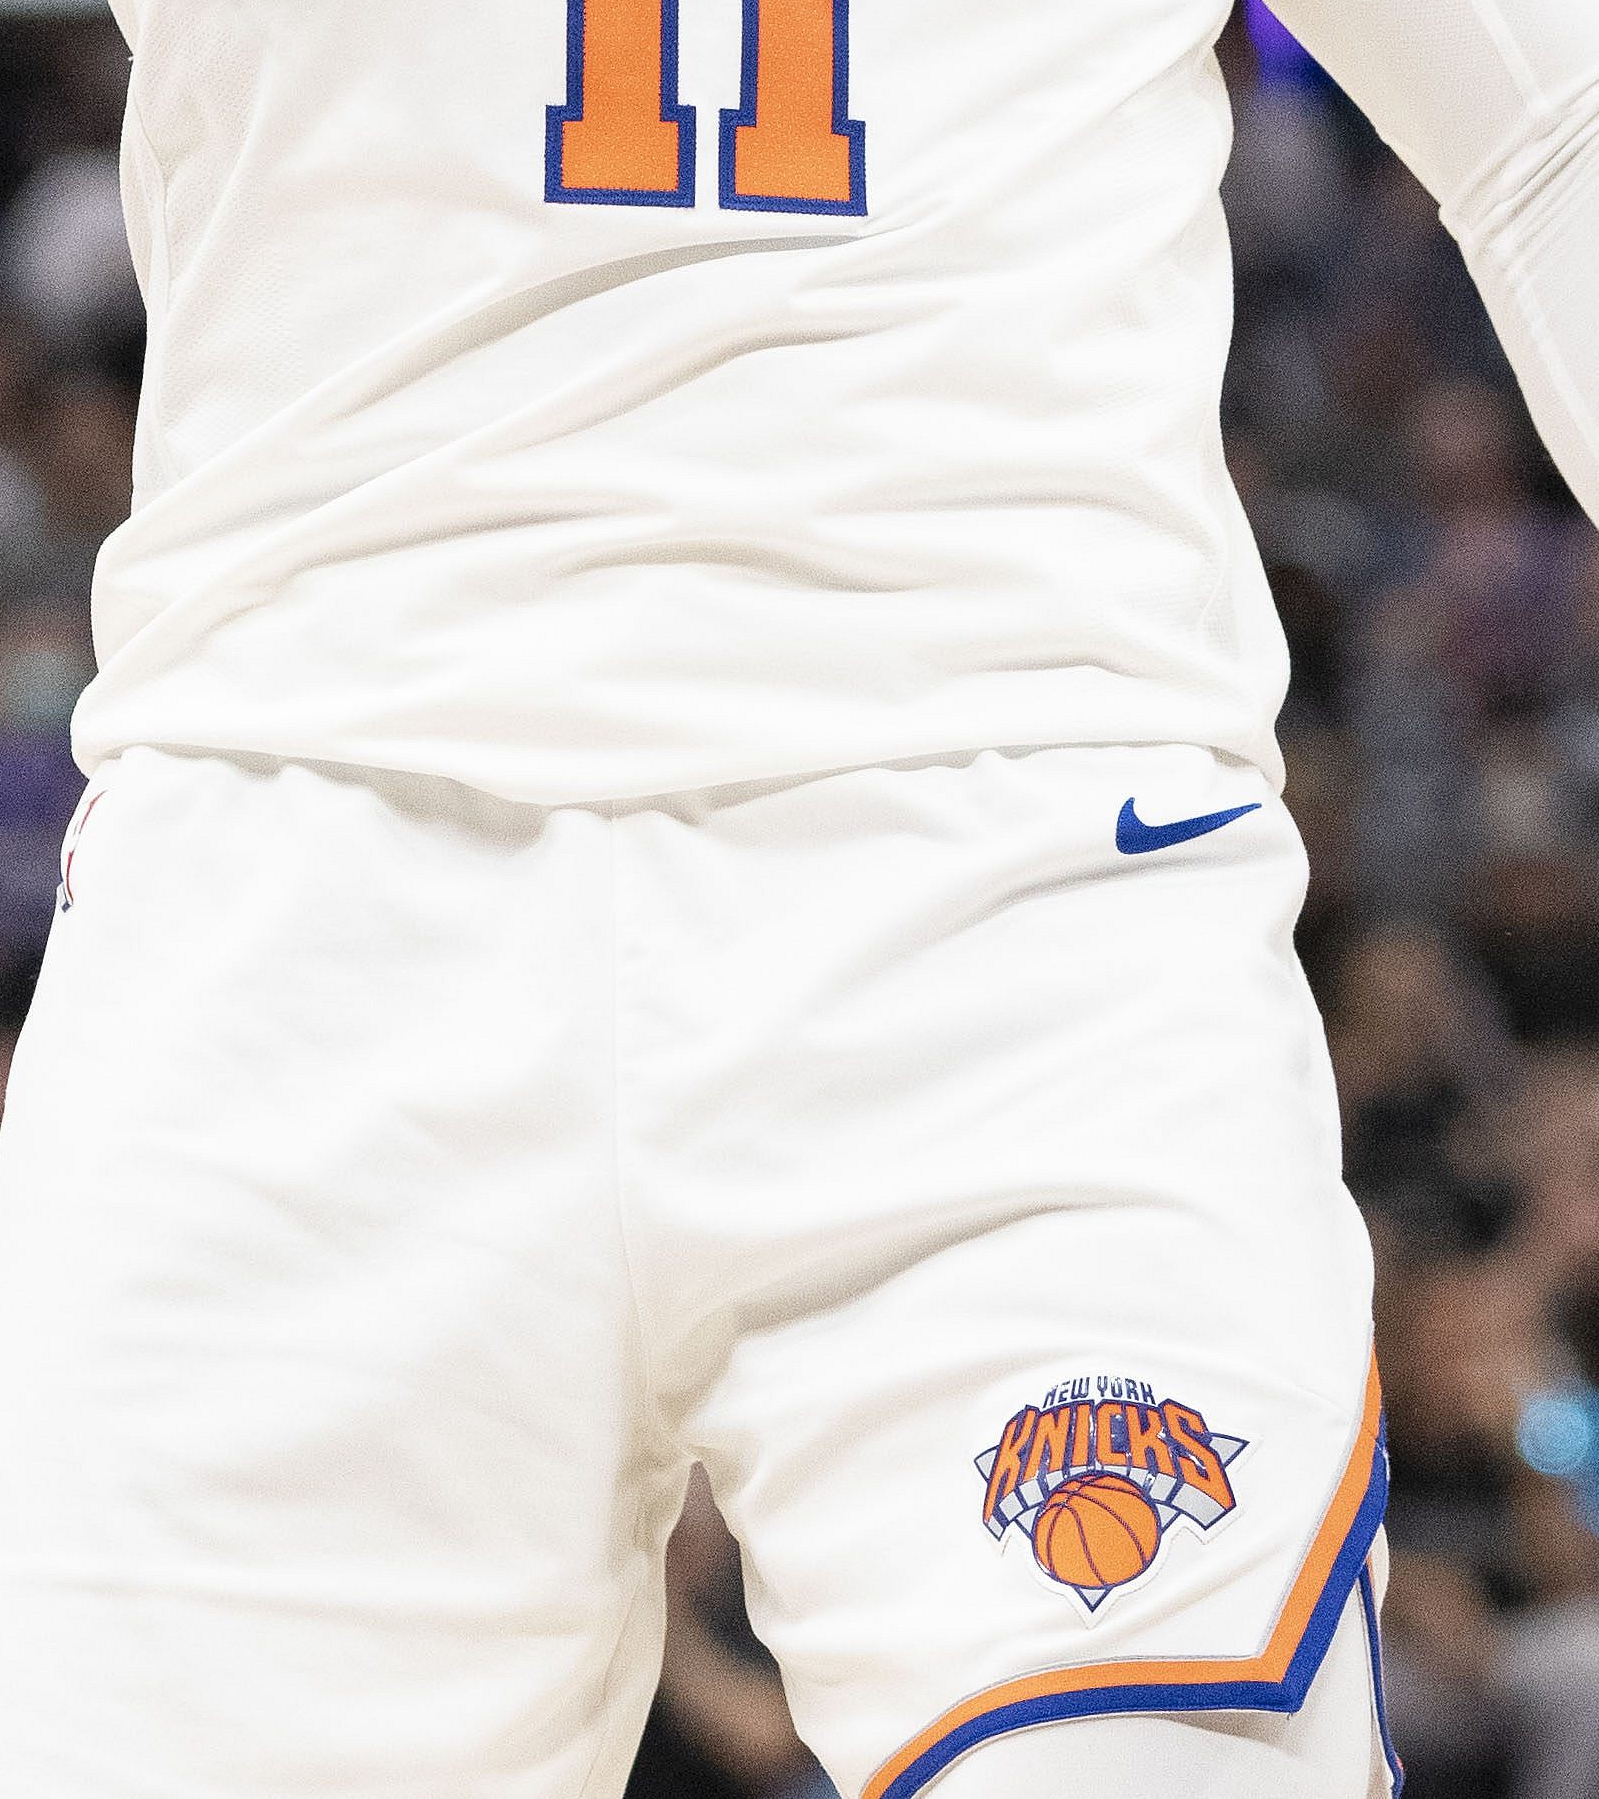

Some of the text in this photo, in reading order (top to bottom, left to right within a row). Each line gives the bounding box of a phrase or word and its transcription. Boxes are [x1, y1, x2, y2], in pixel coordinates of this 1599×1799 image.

[1043, 1376, 1156, 1408] NEW YORK
[982, 1398, 1237, 1531] KNICKS
